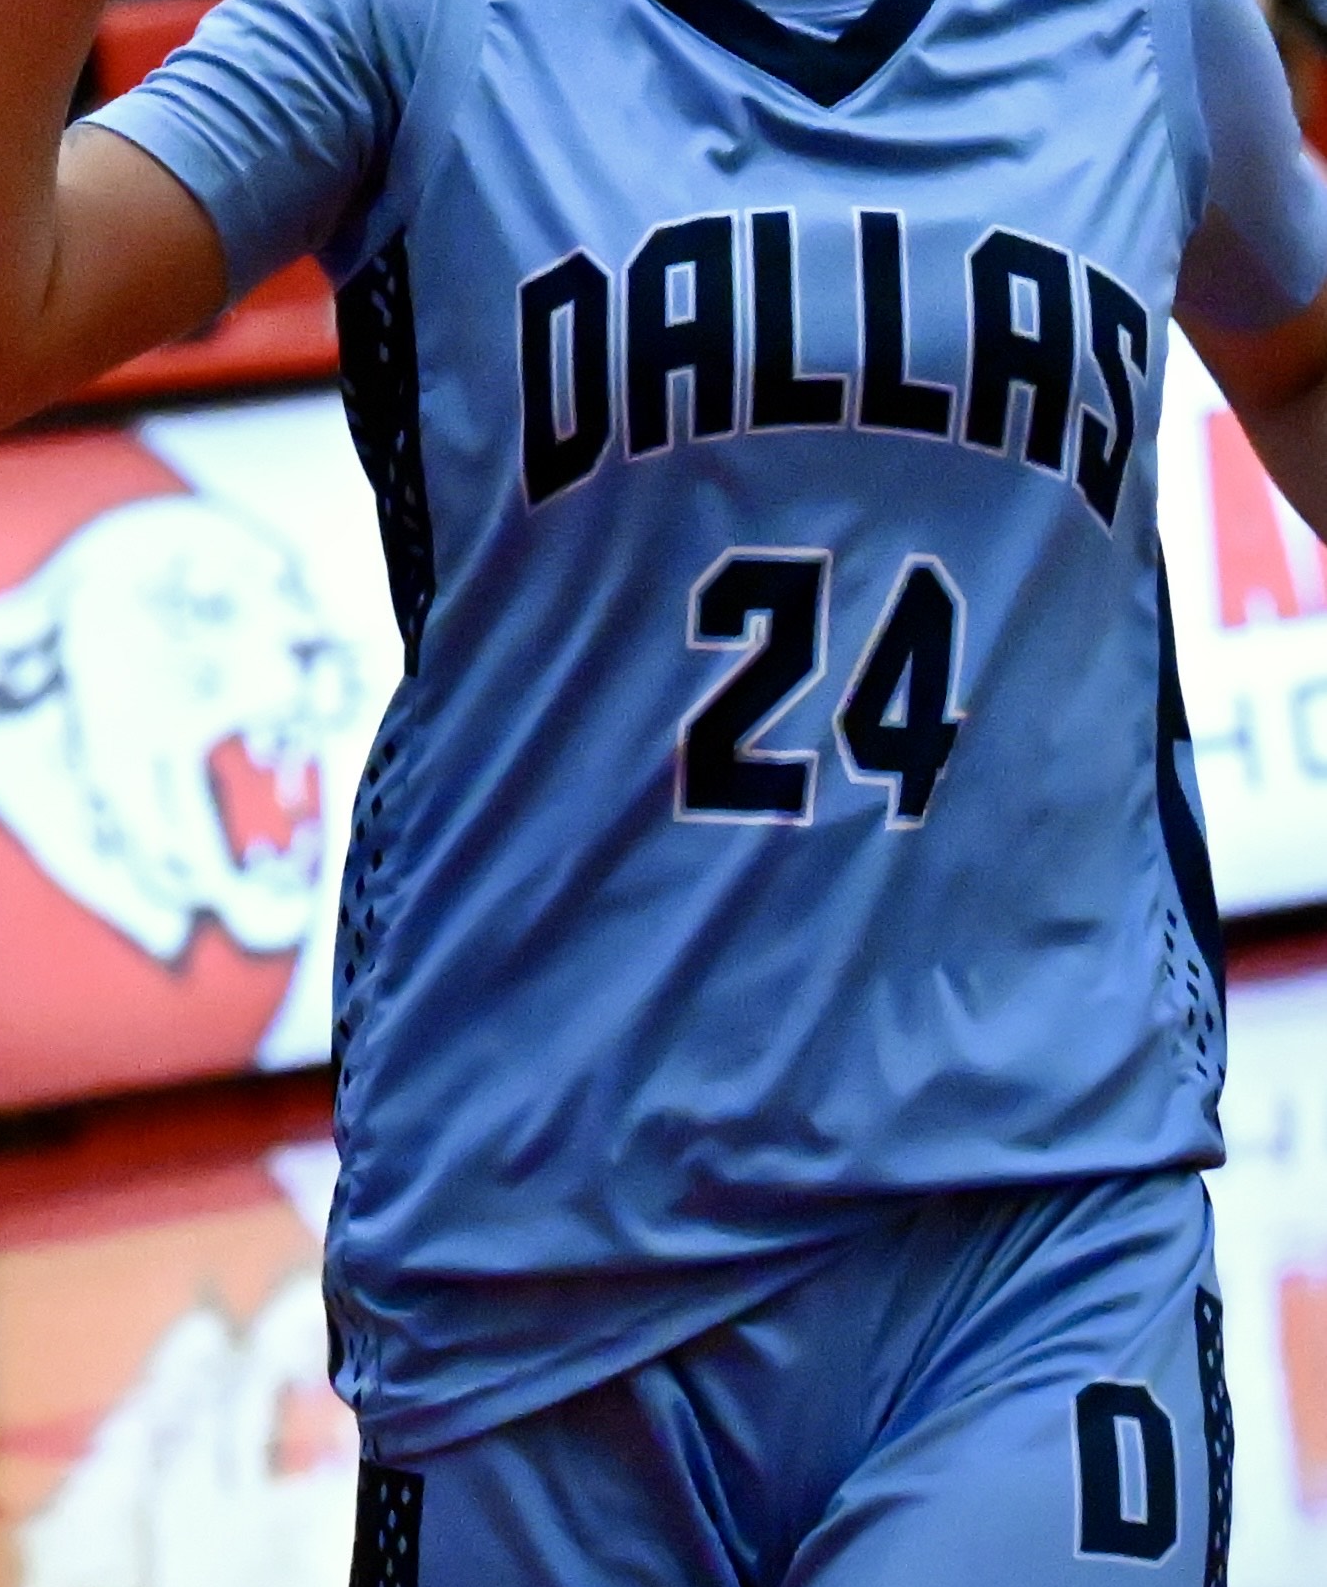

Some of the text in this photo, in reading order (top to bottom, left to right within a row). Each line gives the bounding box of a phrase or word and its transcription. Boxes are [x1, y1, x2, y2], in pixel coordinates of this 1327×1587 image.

[517, 206, 1150, 539] DALLAS
[673, 547, 967, 830] 24
[1072, 1376, 1181, 1569] D
